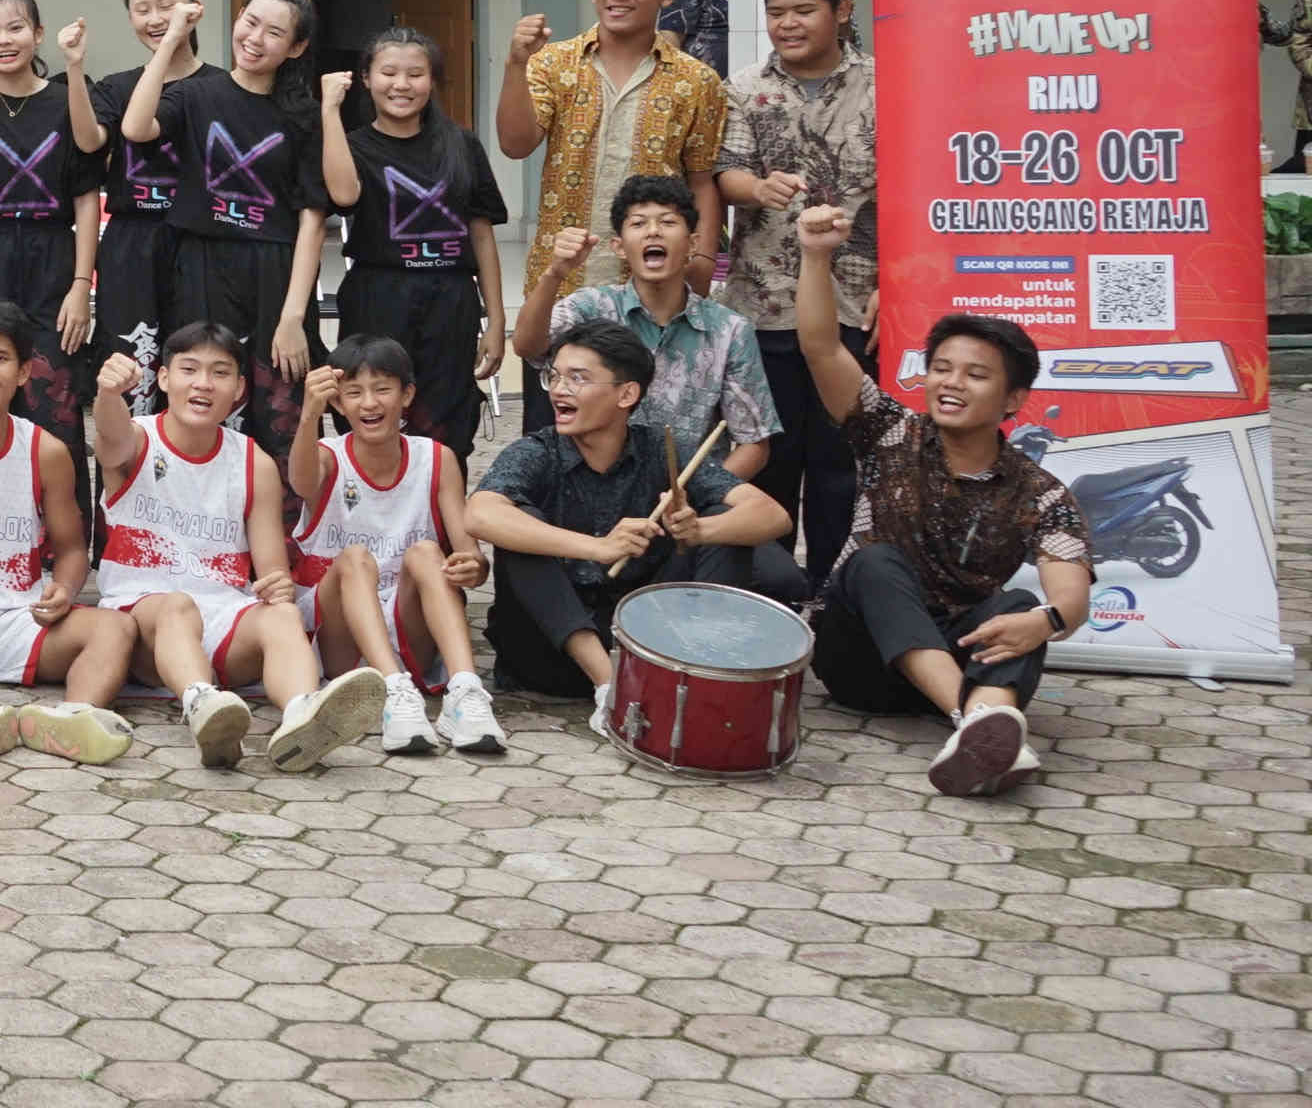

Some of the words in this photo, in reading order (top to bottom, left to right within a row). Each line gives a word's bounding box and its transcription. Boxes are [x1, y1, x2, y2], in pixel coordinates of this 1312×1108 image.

[1027, 74, 1100, 112] RIAU
[948, 131, 1080, 185] 18-26
[1097, 129, 1184, 182] OCT
[929, 199, 1098, 233] GELANGGANG
[1102, 197, 1209, 233] REMAJA
[962, 260, 995, 270] SCAN
[1022, 278, 1076, 292] untuk
[952, 294, 1077, 310] mendapatkan
